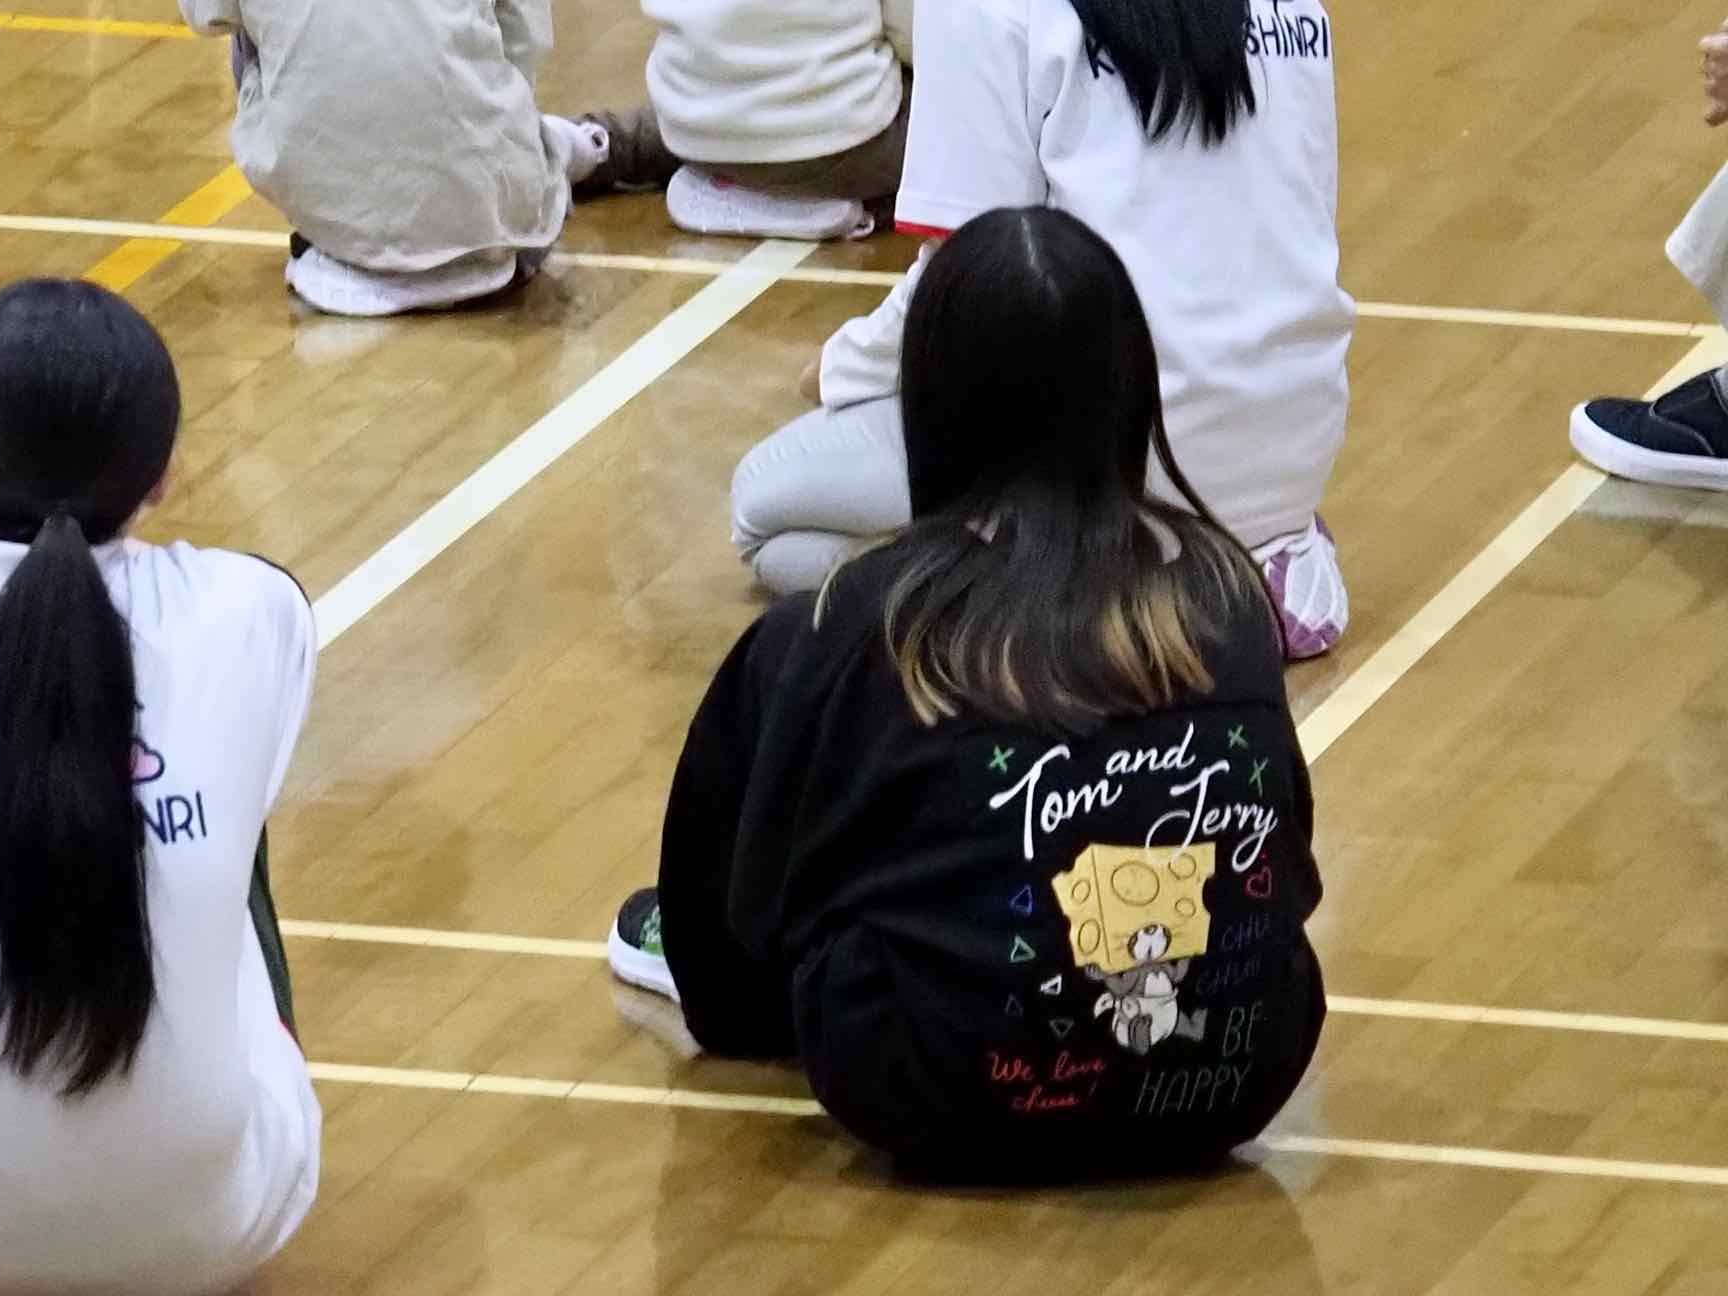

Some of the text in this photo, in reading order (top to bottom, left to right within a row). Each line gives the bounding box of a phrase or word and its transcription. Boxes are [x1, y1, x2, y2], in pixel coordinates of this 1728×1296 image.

[1244, 13, 1329, 60] SHINRI
[1106, 720, 1197, 775] and
[142, 790, 208, 845] NRI
[989, 744, 1124, 860] Tom
[1146, 760, 1279, 873] Jerry
[987, 1051, 1034, 1081] We
[1135, 1060, 1253, 1116] HAPPY
